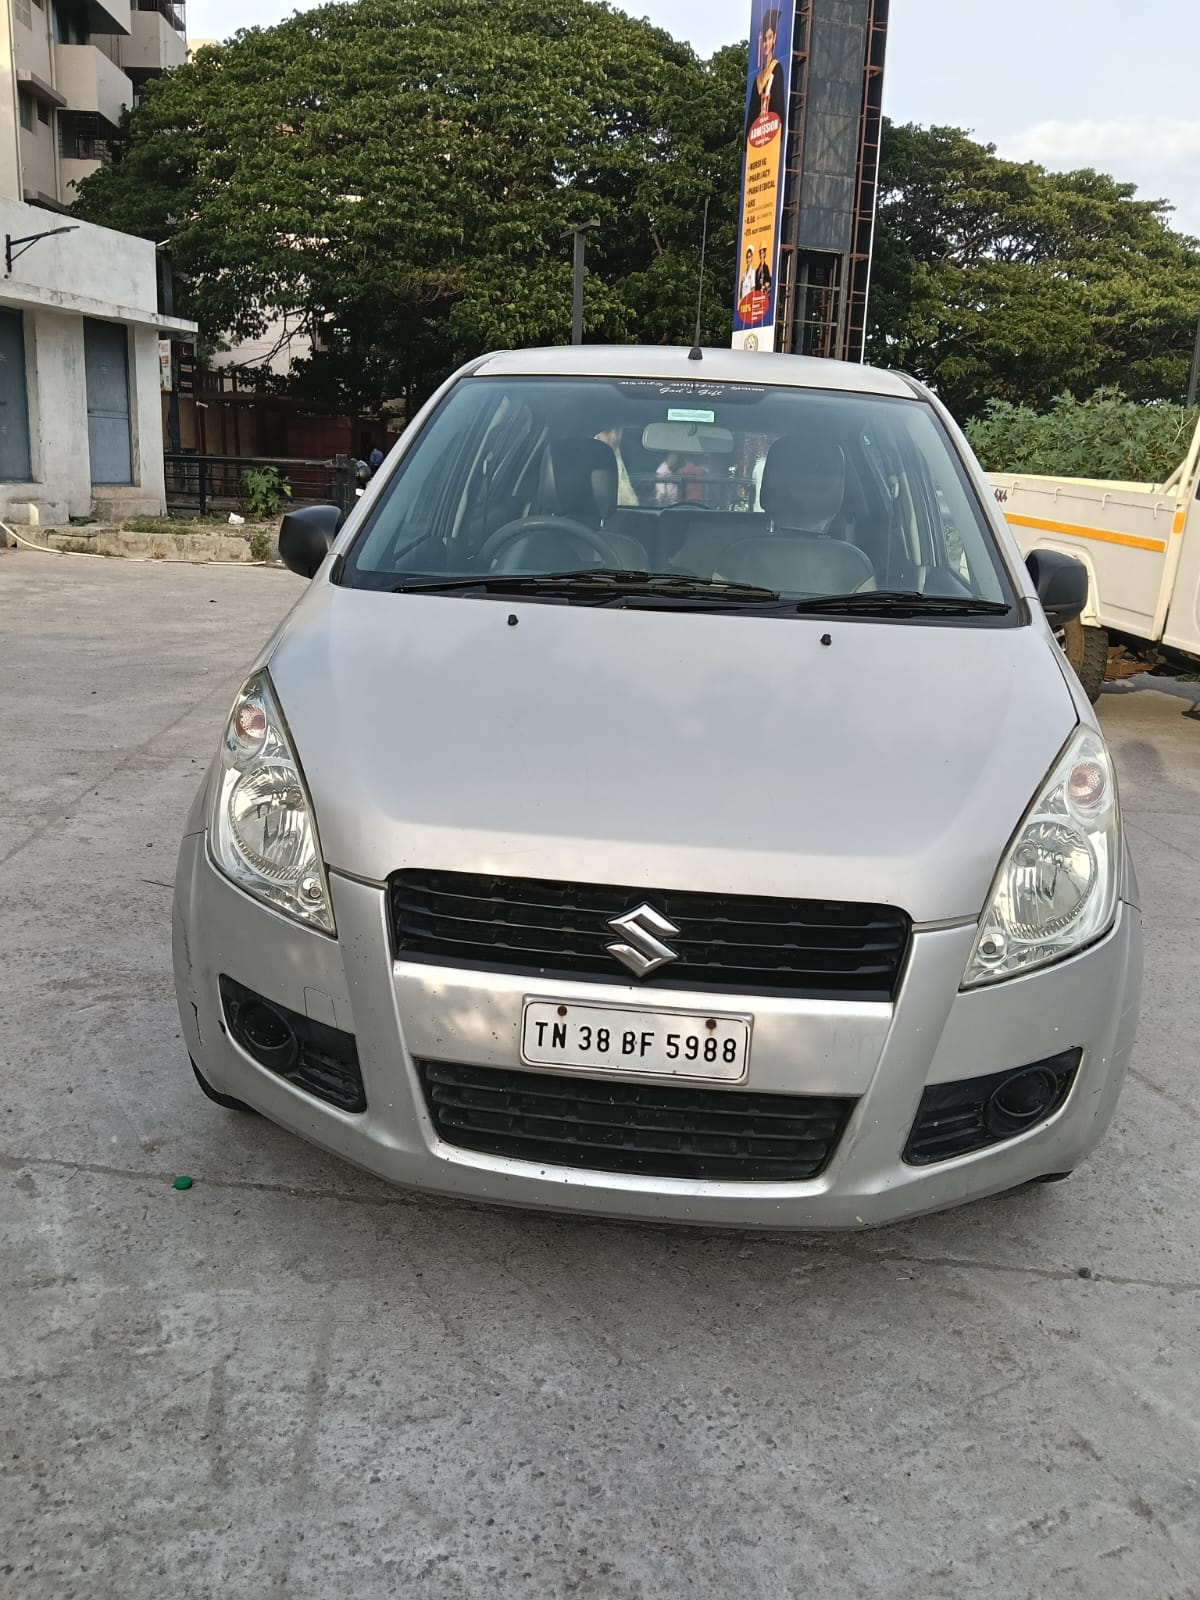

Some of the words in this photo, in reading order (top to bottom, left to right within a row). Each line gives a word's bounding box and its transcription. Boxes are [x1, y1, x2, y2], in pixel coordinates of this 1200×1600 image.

[535, 1022, 567, 1049] TN
[578, 1026, 610, 1053] 38
[621, 1031, 655, 1058] BF
[666, 1033, 737, 1064] 5988
